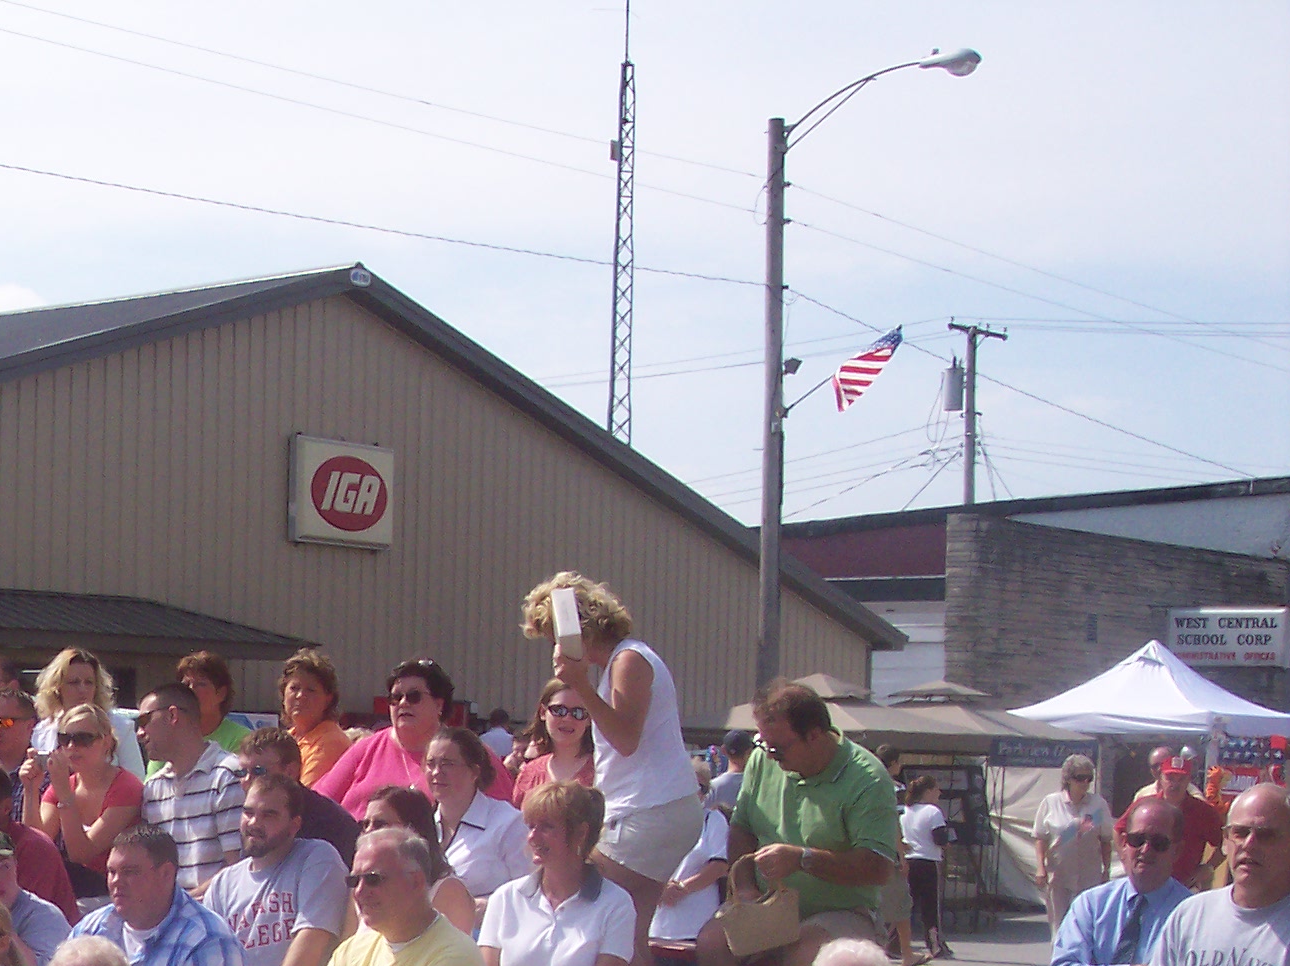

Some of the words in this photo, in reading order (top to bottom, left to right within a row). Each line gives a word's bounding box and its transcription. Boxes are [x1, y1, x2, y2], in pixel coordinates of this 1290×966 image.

[321, 471, 381, 515] IGA
[1174, 617, 1209, 629] WEST
[1218, 617, 1278, 629] CENTRAL
[1177, 634, 1227, 646] SCHOOL
[1237, 634, 1272, 646] CORP
